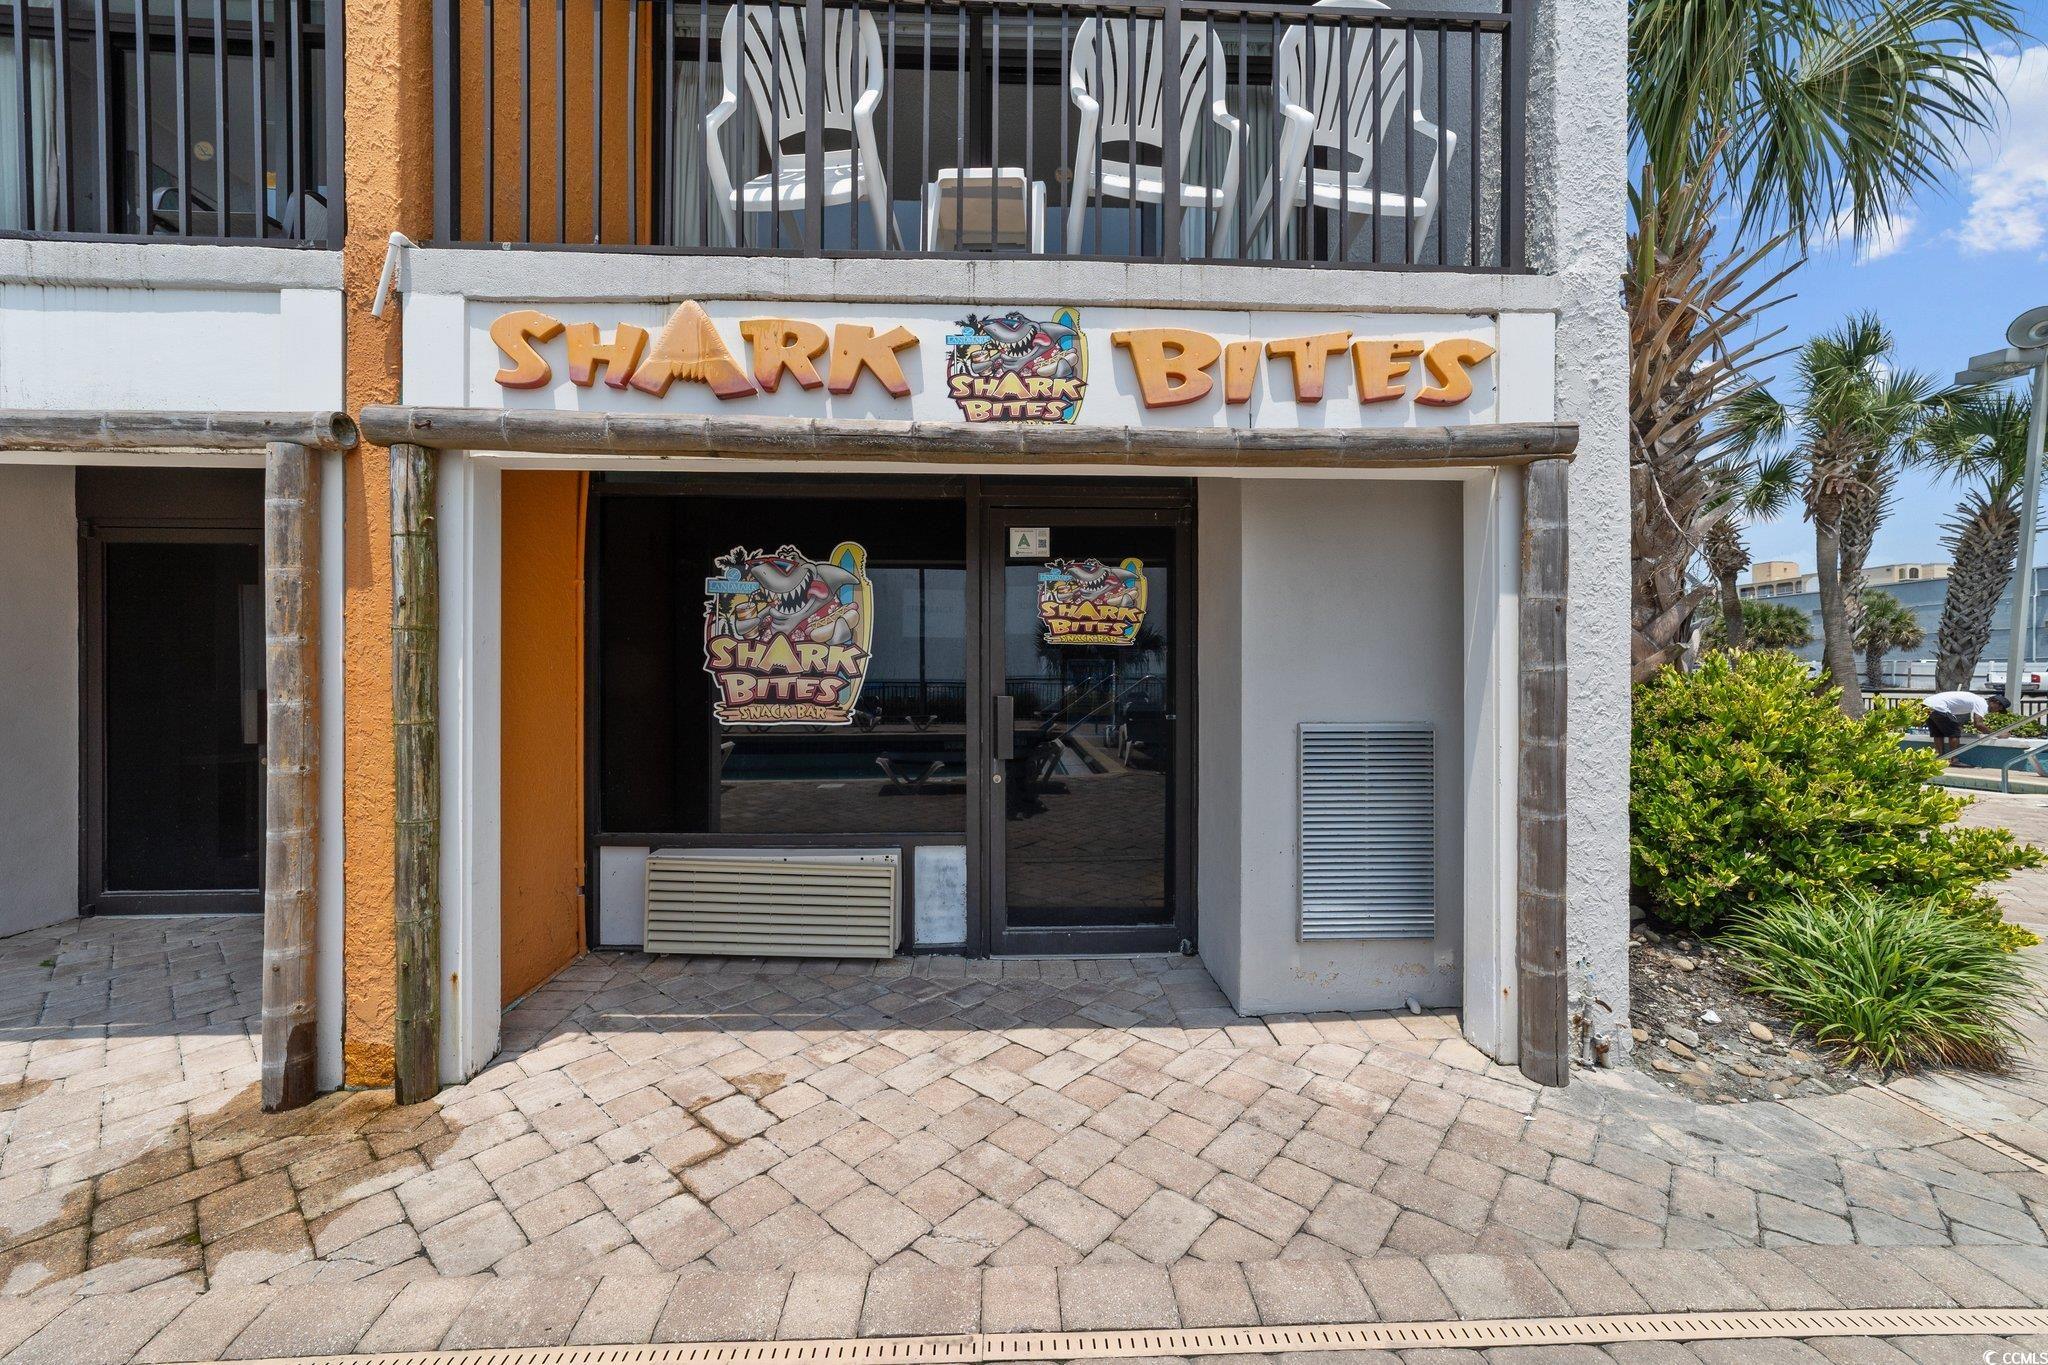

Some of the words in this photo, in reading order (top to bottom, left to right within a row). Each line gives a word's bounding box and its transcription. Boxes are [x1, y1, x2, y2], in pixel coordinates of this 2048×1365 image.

[490, 299, 920, 399] SHARK
[1110, 328, 1496, 409] BITES
[951, 372, 1082, 399] SHARK
[961, 400, 1068, 422] BITES
[1018, 533, 1030, 547] A
[1041, 600, 1140, 622] SHARK
[1048, 619, 1128, 634] BITES
[1060, 634, 1094, 643] SNACK
[1097, 634, 1117, 644] BAR
[711, 633, 863, 674] SHARK
[719, 672, 845, 704] BITES
[739, 703, 792, 719] SNACK
[796, 704, 827, 719] BAR
